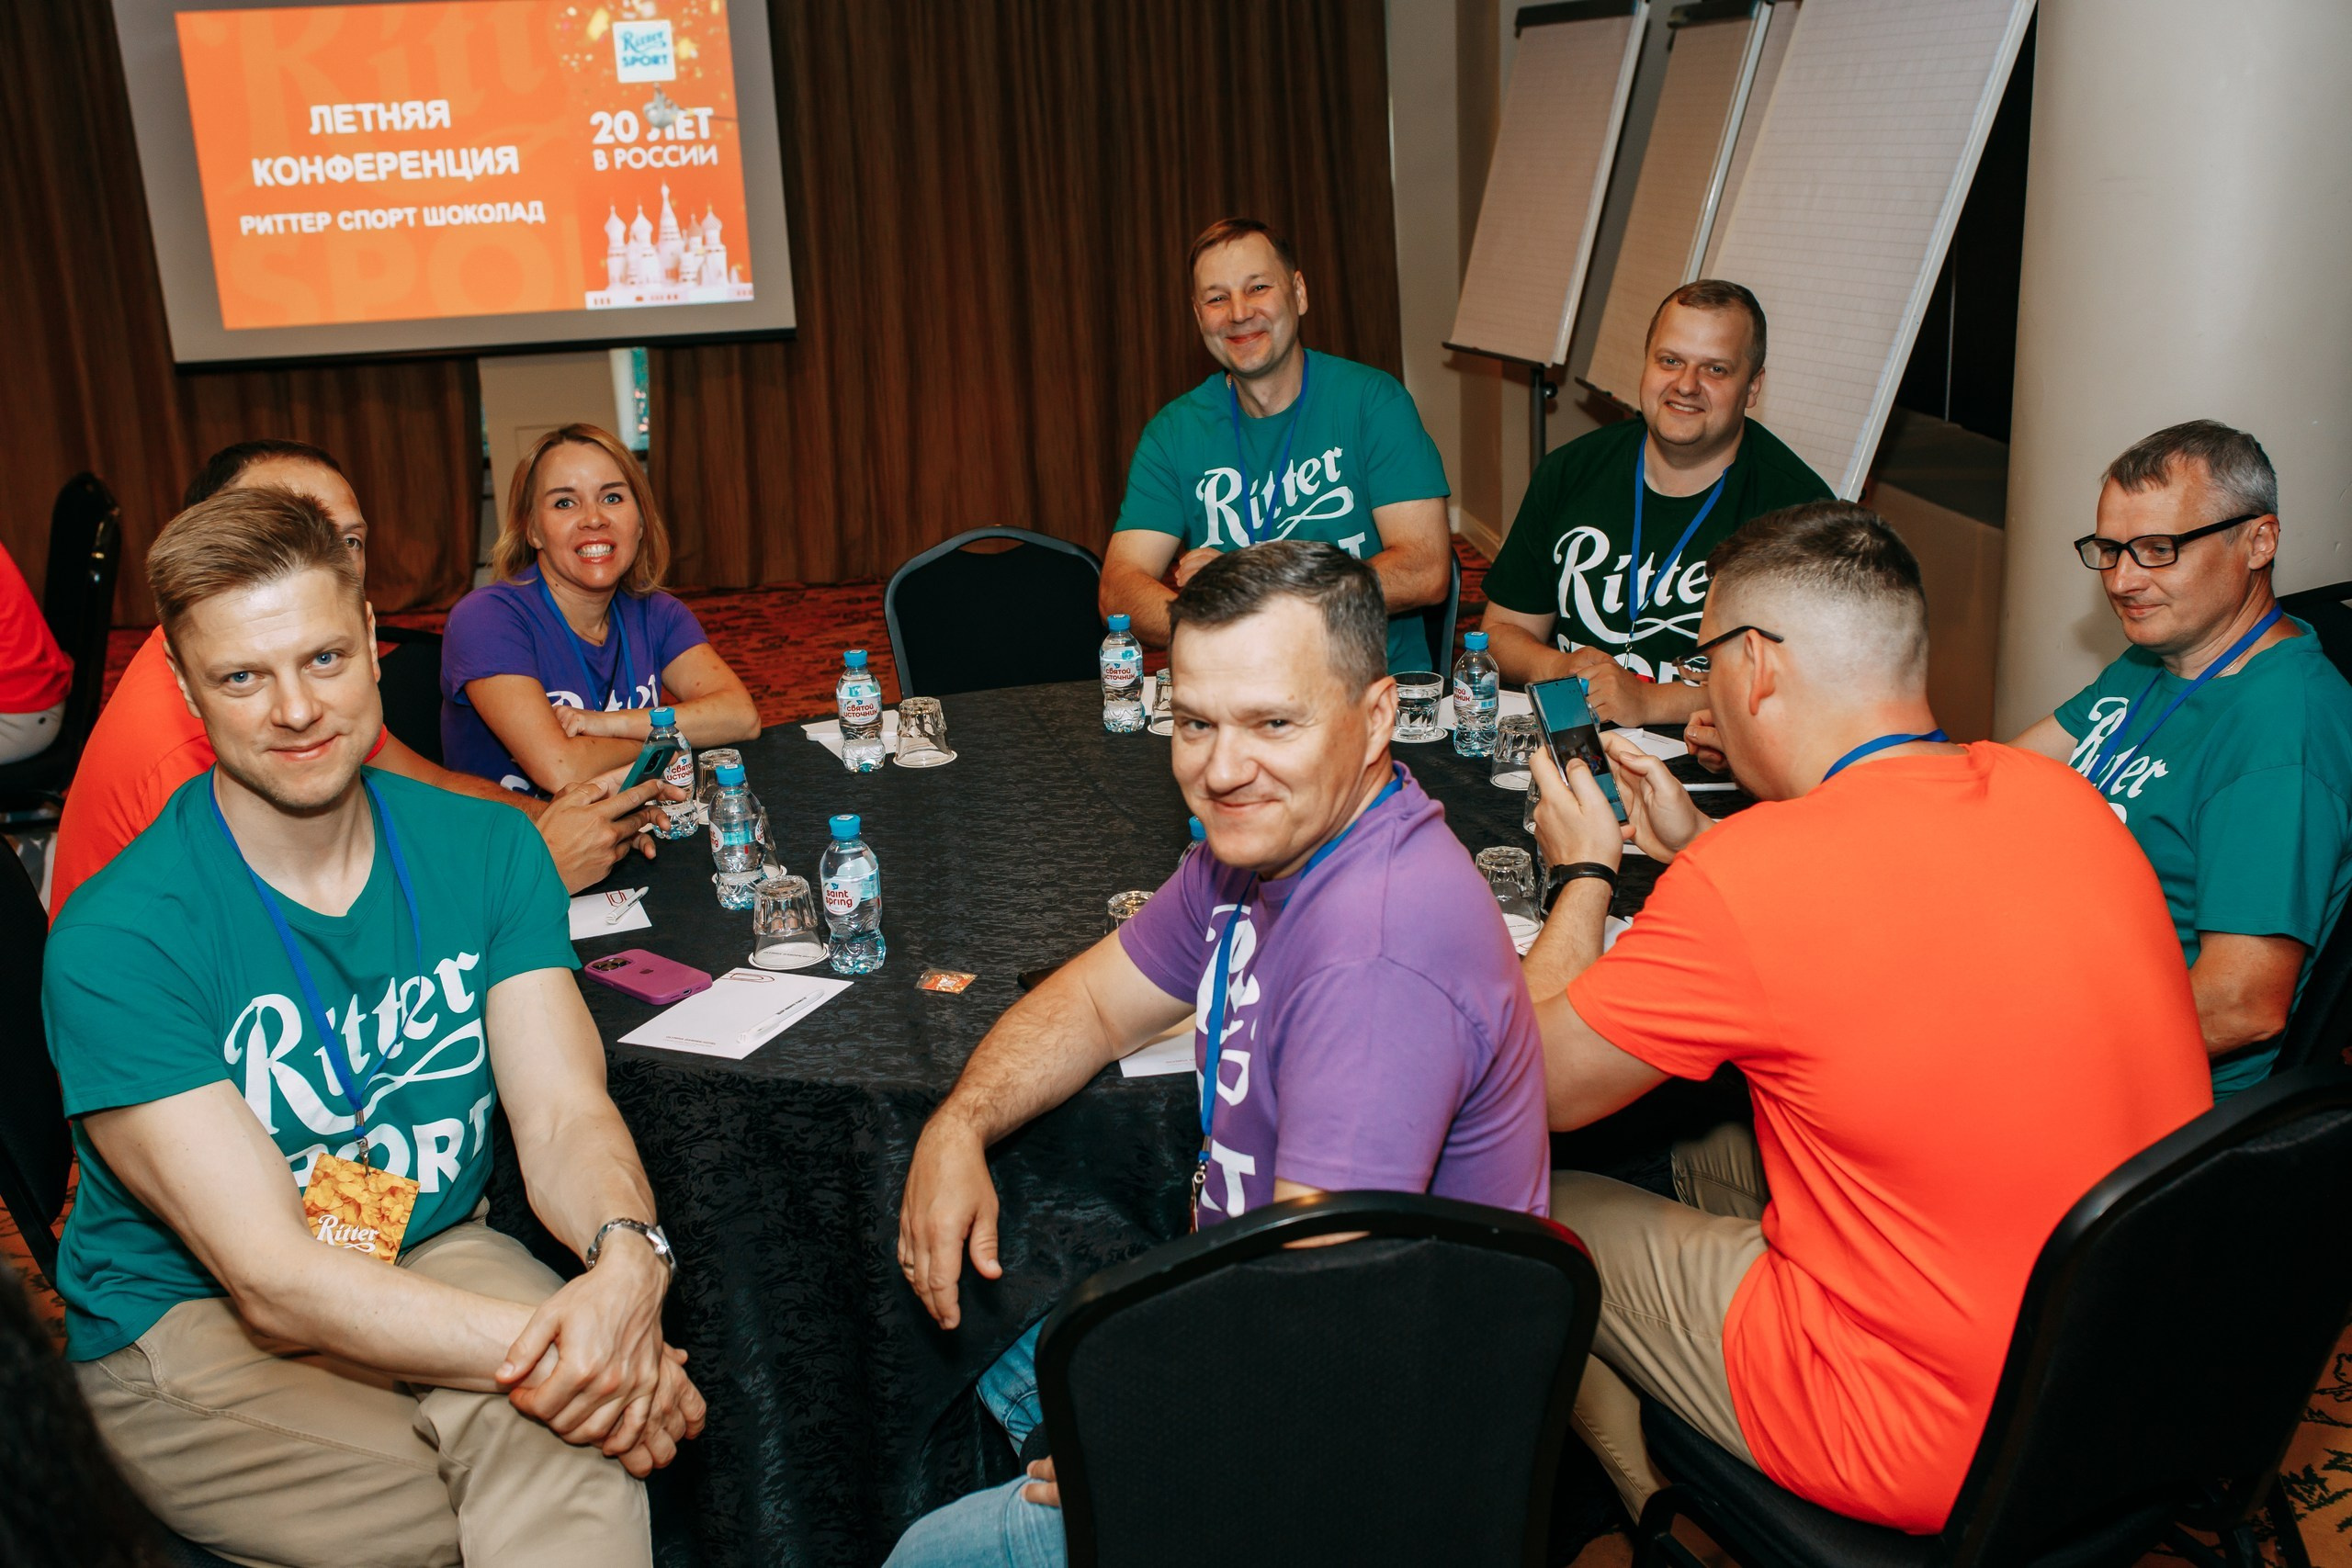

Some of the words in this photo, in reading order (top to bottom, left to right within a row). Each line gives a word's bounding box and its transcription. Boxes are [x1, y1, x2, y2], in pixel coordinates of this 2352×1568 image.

[622, 30, 667, 53] Ritter
[622, 54, 668, 67] SPORT
[310, 99, 451, 135] ЛЕТНЯЯ
[590, 110, 639, 144] 20
[251, 145, 520, 187] КОНФЕРЕНЦИЯ
[593, 149, 608, 171] В
[614, 144, 718, 170] РОССИИ
[240, 210, 332, 235] РИТТЕР
[337, 207, 417, 231] СПОРТ
[423, 200, 547, 227] ШОКОЛАД
[1195, 446, 1354, 548] Ritter
[1554, 525, 1707, 643] Ritte
[843, 708, 878, 717] источник
[846, 704, 874, 712] святой
[671, 762, 693, 774] свято
[826, 897, 854, 908] spring
[827, 890, 849, 898] saint
[224, 952, 485, 1135] Ritter
[316, 1214, 379, 1253] Ritter
